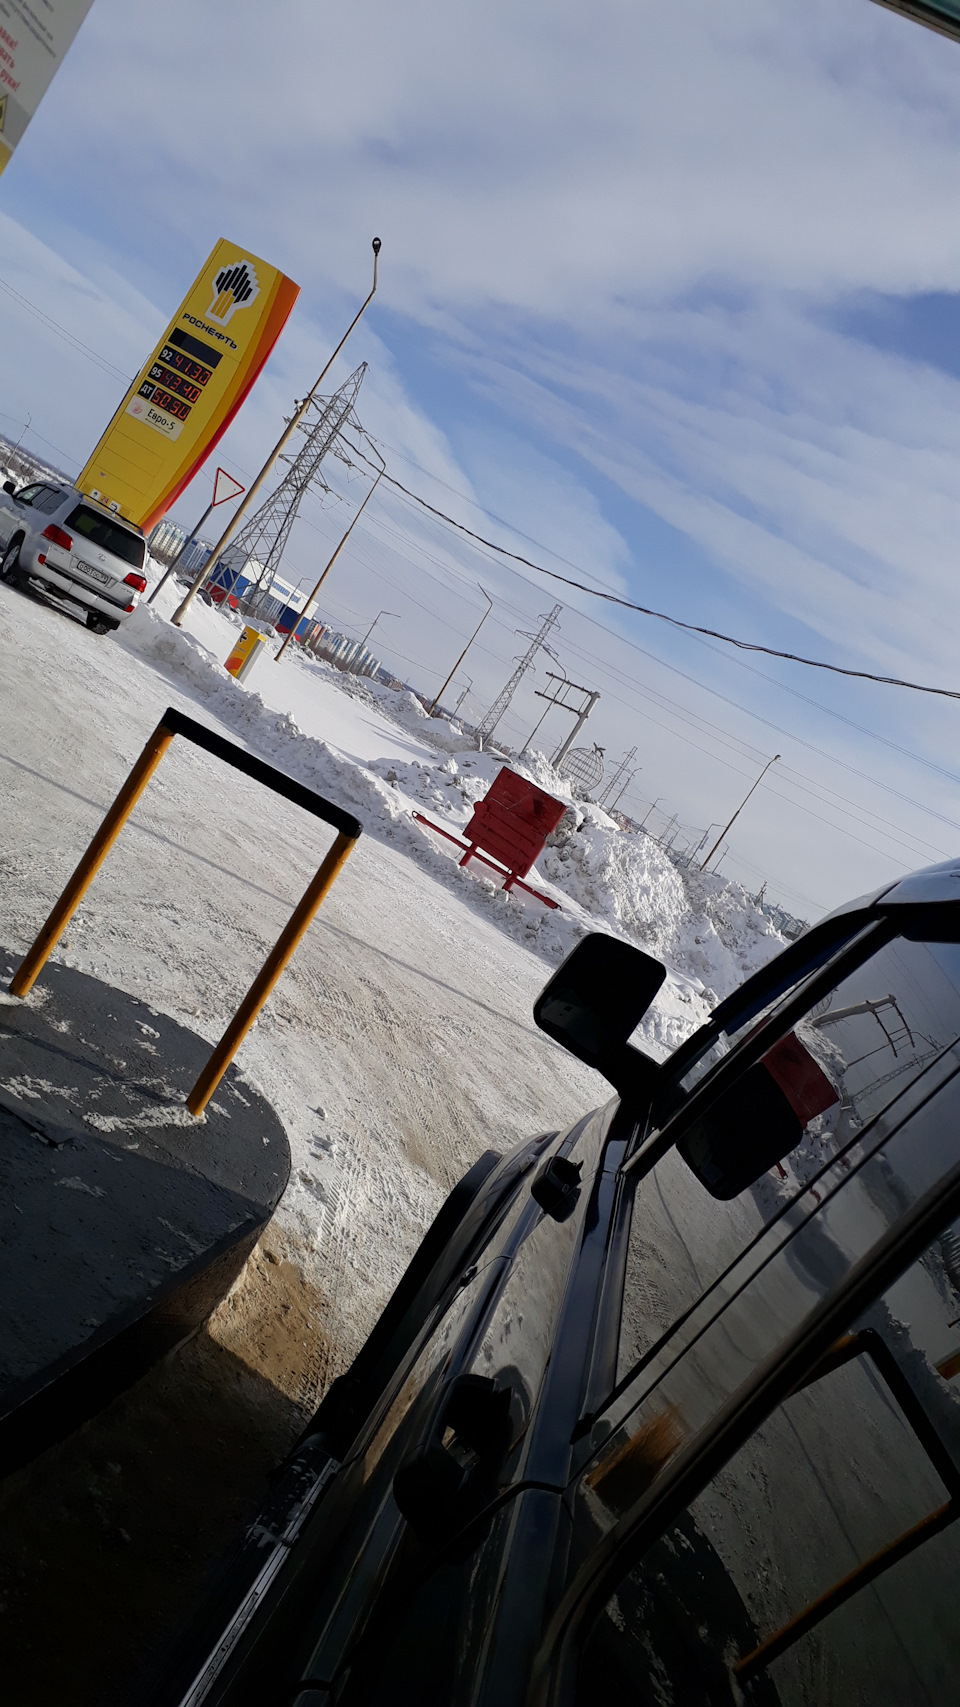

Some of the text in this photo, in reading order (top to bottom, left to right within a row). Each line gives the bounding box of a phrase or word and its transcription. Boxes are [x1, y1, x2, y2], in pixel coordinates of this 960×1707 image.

[182, 312, 238, 350] РОСНЕФТЬ
[150, 366, 201, 402] 95 43.40
[160, 348, 211, 385] 92 41.30
[140, 384, 190, 420] ДТ 50.90
